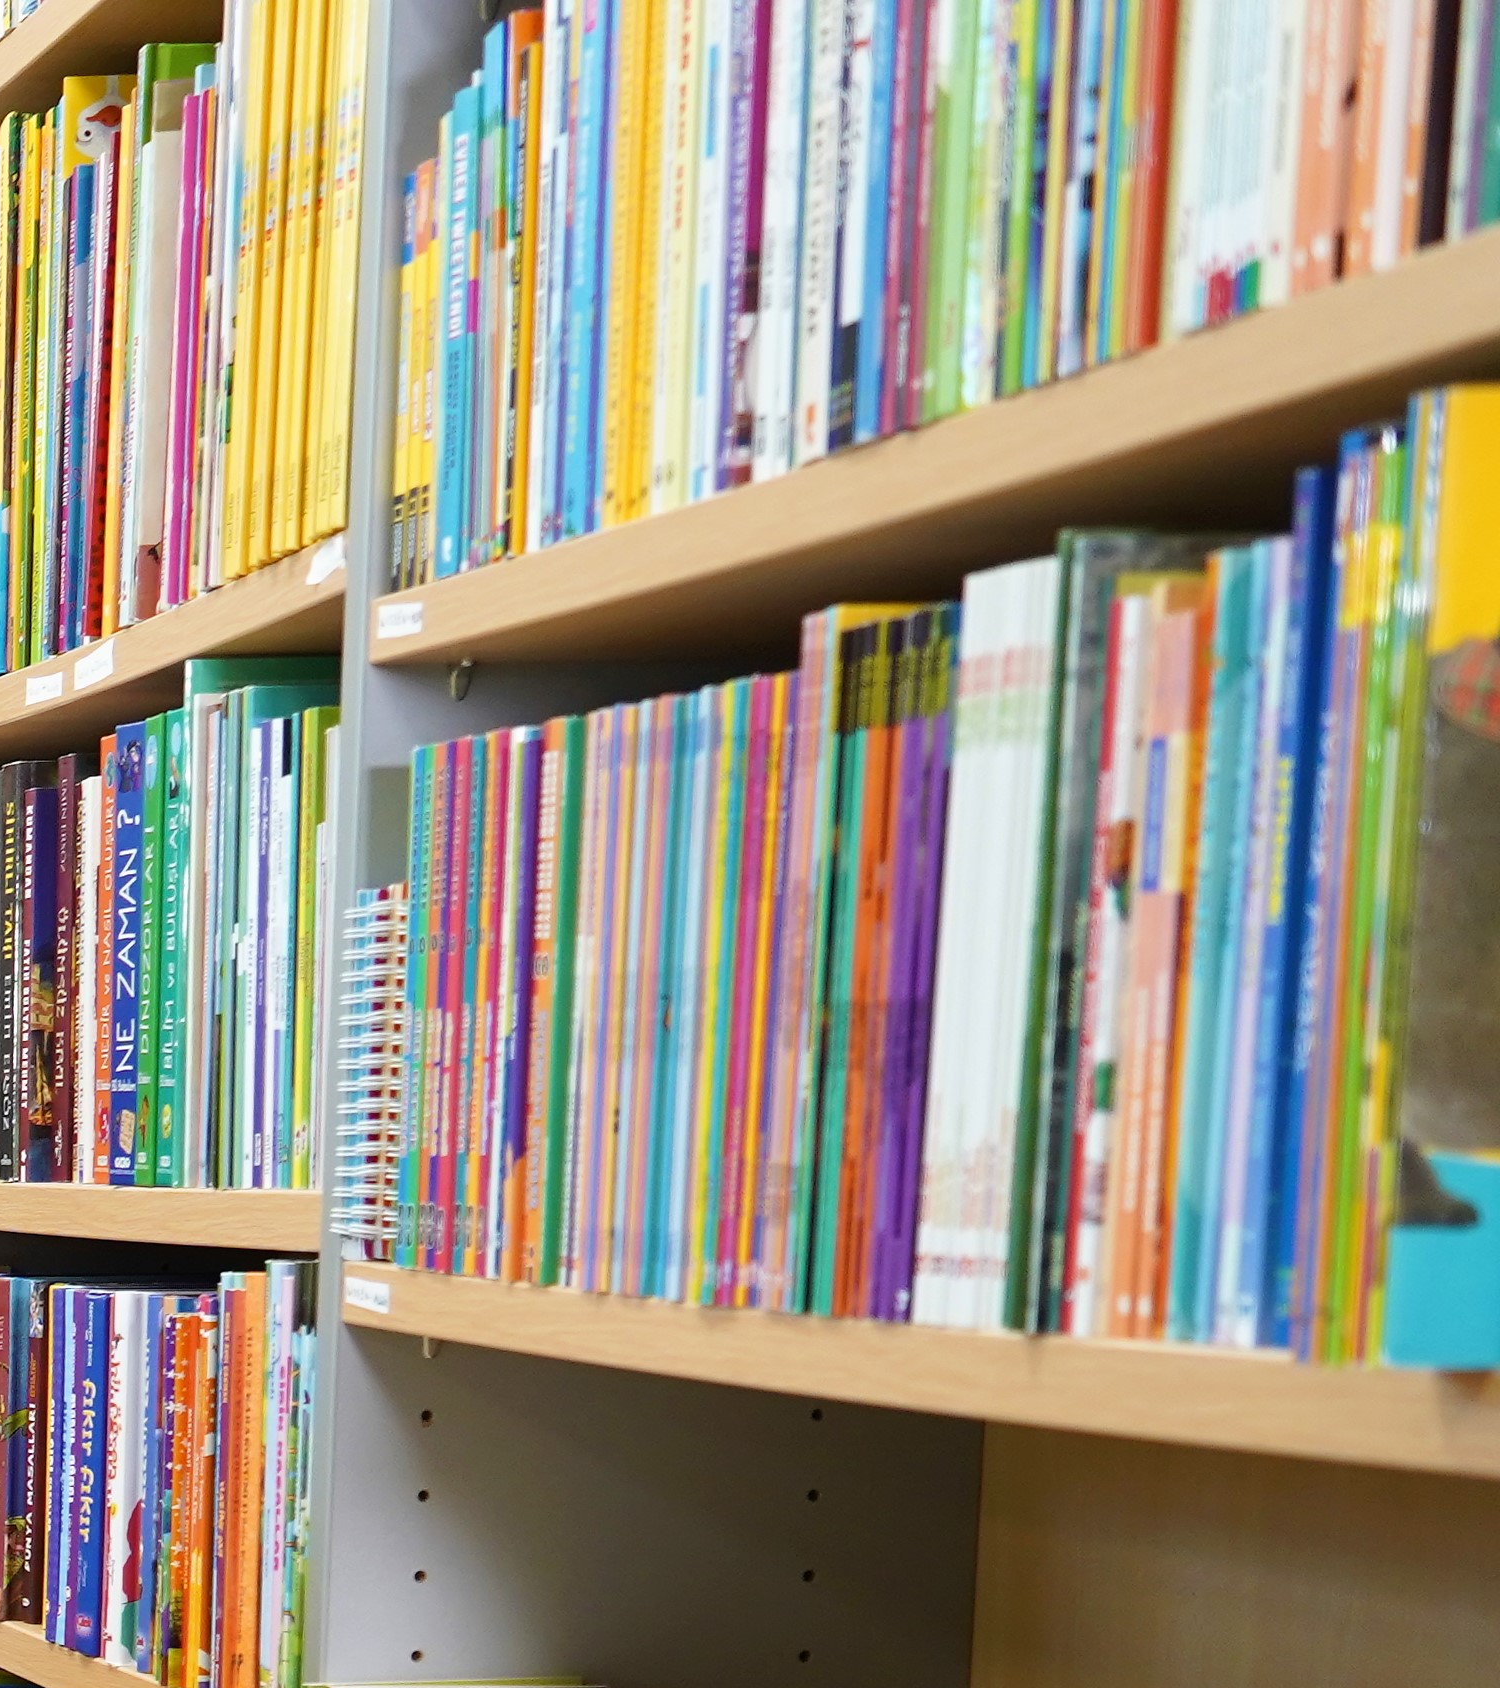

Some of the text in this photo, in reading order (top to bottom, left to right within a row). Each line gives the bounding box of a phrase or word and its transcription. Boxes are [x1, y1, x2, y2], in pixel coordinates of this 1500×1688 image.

[23, 804, 34, 899] KUMANDAN
[98, 795, 116, 1071] NEDİR ve NASIL OLUŞUR?
[114, 809, 141, 1072] NE ZAMAN ?
[159, 804, 180, 1070] BİLİM ve BULUŞLAR!
